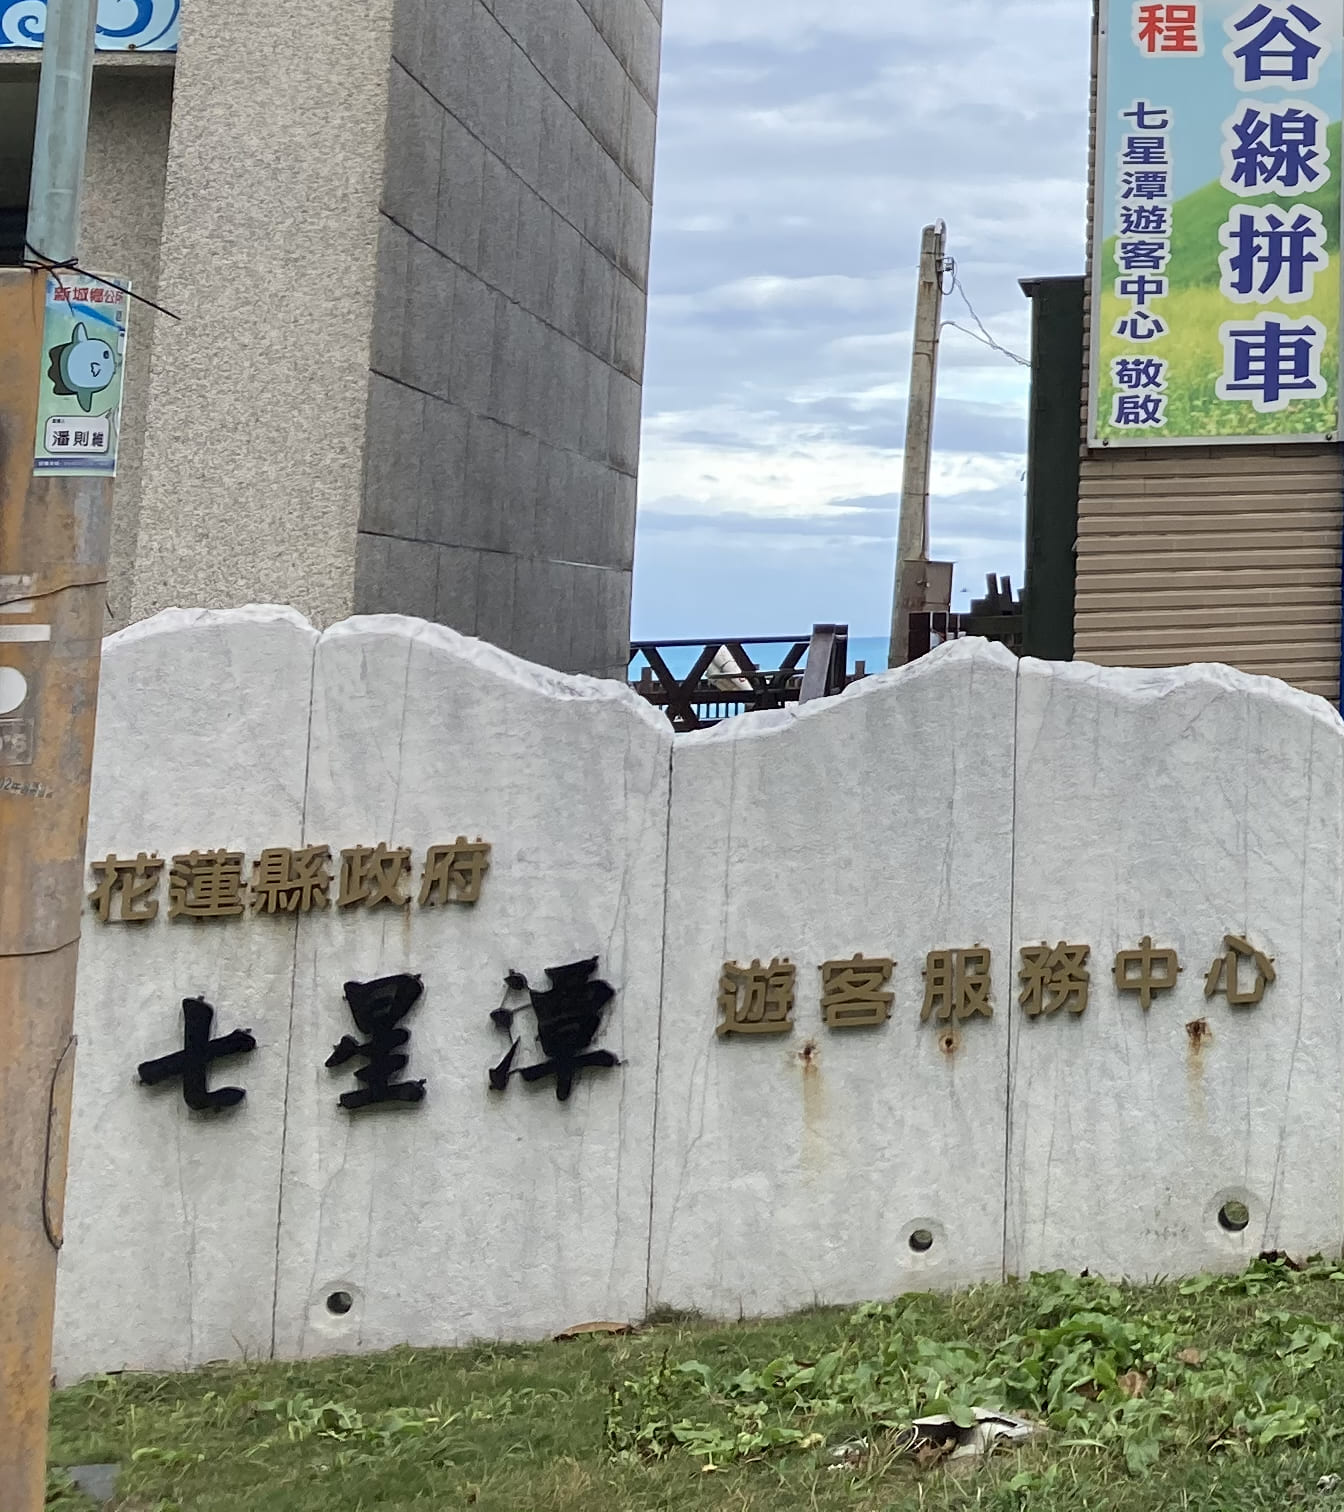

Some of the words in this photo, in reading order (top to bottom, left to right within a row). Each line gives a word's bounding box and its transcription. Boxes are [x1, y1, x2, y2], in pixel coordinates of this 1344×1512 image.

[1116, 100, 1169, 340] 七星潭遊客中心
[1114, 359, 1164, 425] 敬啟
[87, 835, 493, 925] 花蓮縣政府
[136, 954, 621, 1112] 七星潭
[714, 933, 1277, 1038] 遊客服務中心
